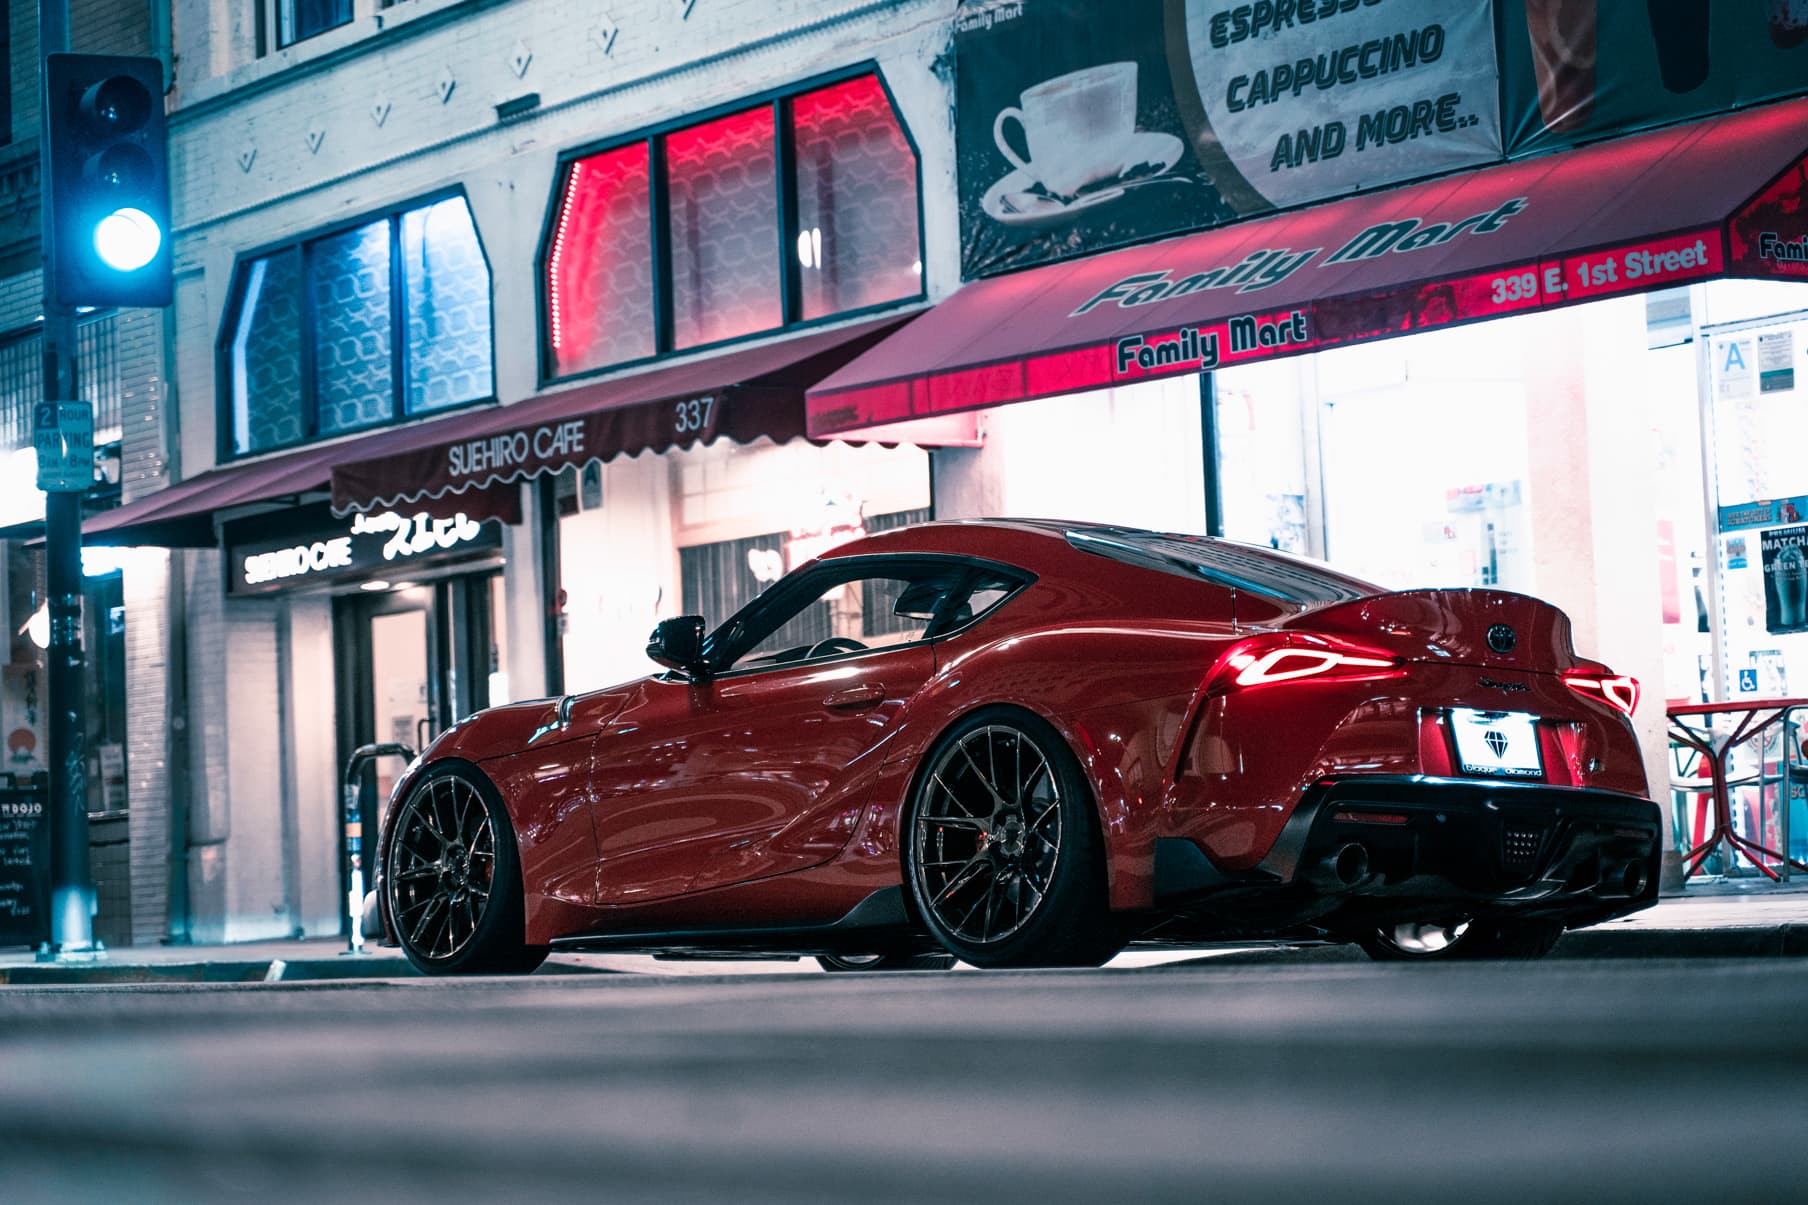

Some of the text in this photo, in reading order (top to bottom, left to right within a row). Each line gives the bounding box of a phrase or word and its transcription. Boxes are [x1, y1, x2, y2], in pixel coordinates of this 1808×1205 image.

[1225, 23, 1445, 113] CAPPUCCINO
[1270, 92, 1480, 172] AND MORE..
[1068, 197, 1528, 318] Family Mart
[1491, 239, 1708, 304] 339 E. 1st Street
[1758, 231, 1808, 262] Fami
[1115, 310, 1308, 375] Family Mart
[1724, 342, 1745, 372] A
[39, 406, 52, 427] 2
[674, 397, 714, 433] 337
[448, 420, 585, 477] SUEHIRO CAFE
[1762, 536, 1808, 551] MATCH
